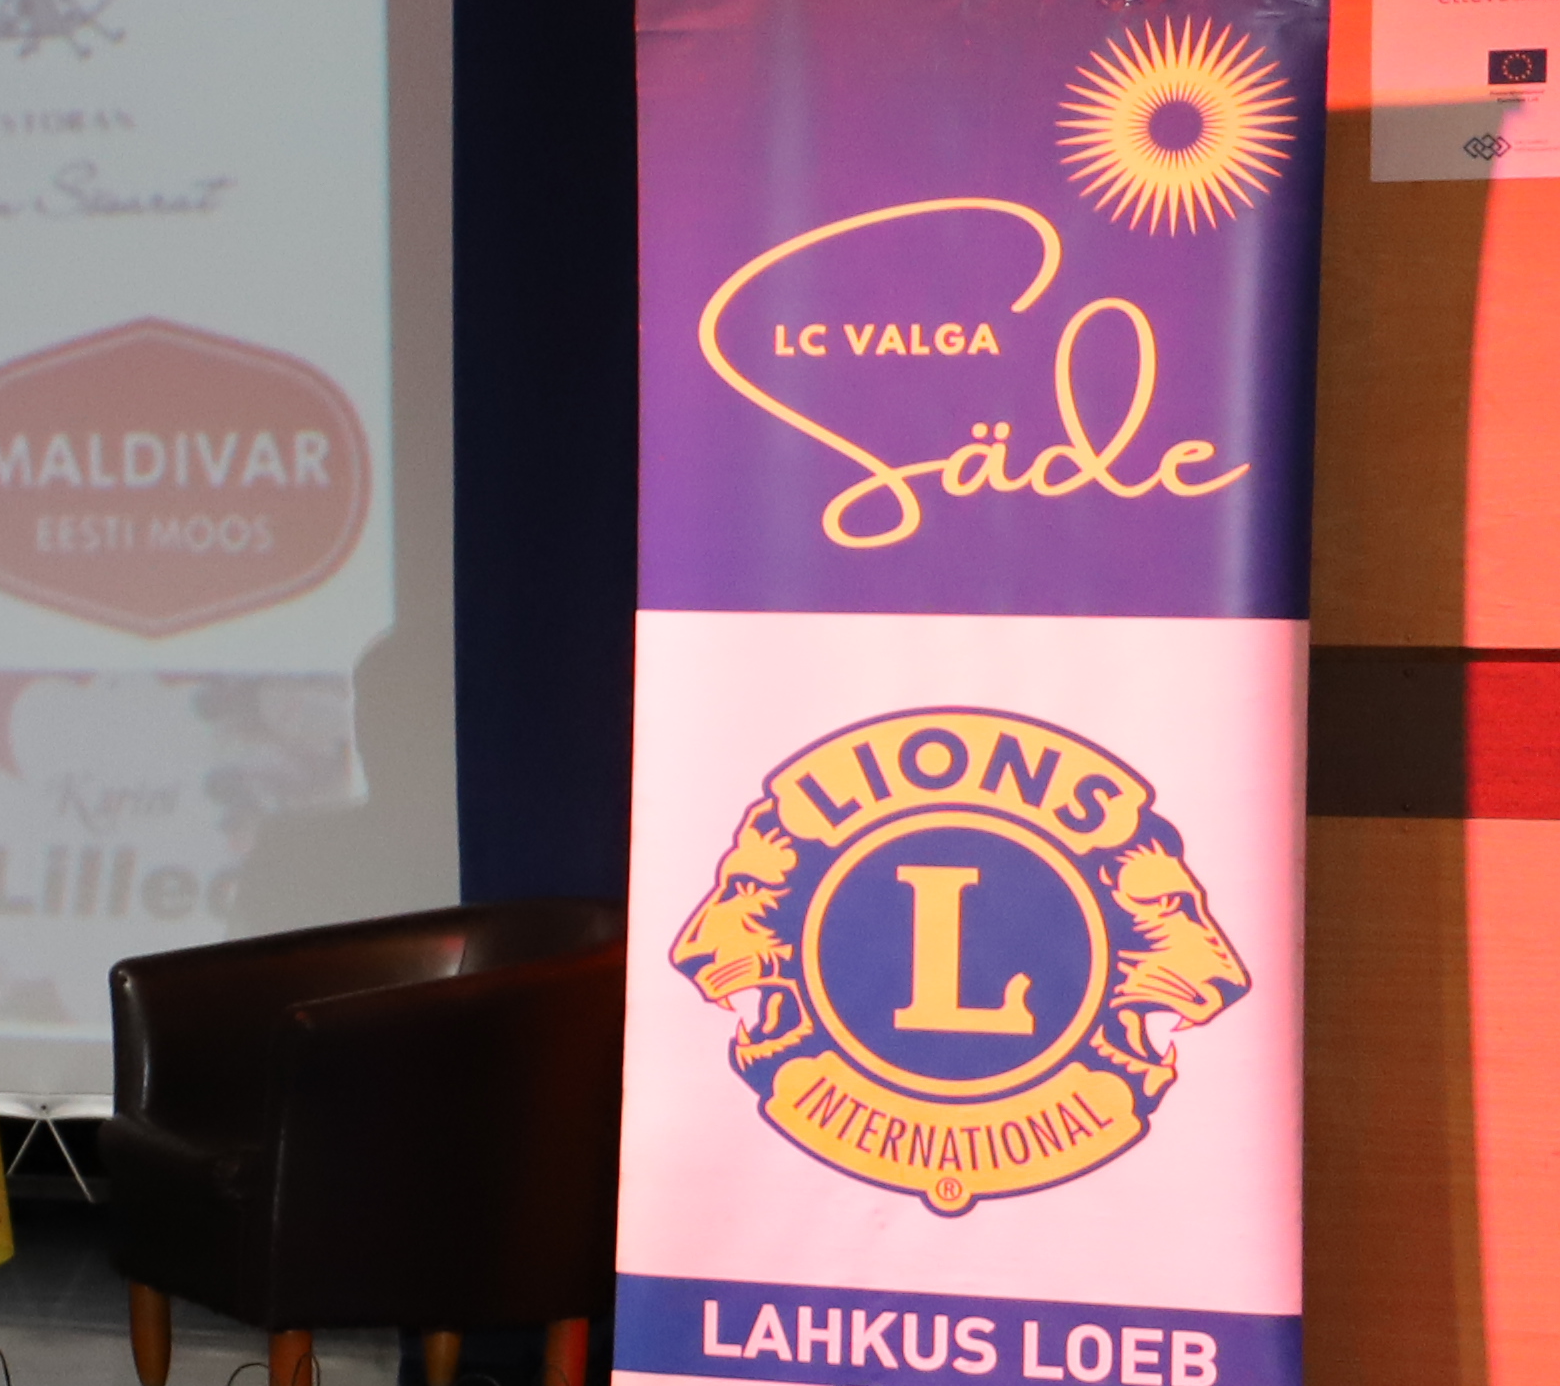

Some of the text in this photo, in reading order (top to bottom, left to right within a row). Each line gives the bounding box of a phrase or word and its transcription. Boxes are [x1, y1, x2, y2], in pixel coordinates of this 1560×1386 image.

[697, 195, 1252, 551] Säde
[774, 322, 1003, 358] LC VALGA
[33, 513, 274, 556] EESTI MOOS
[794, 726, 1124, 835] LIONS
[892, 864, 1036, 1035] L
[793, 1074, 1115, 1173] INTERNATIONAL
[702, 1298, 998, 1377] LAHKUS
